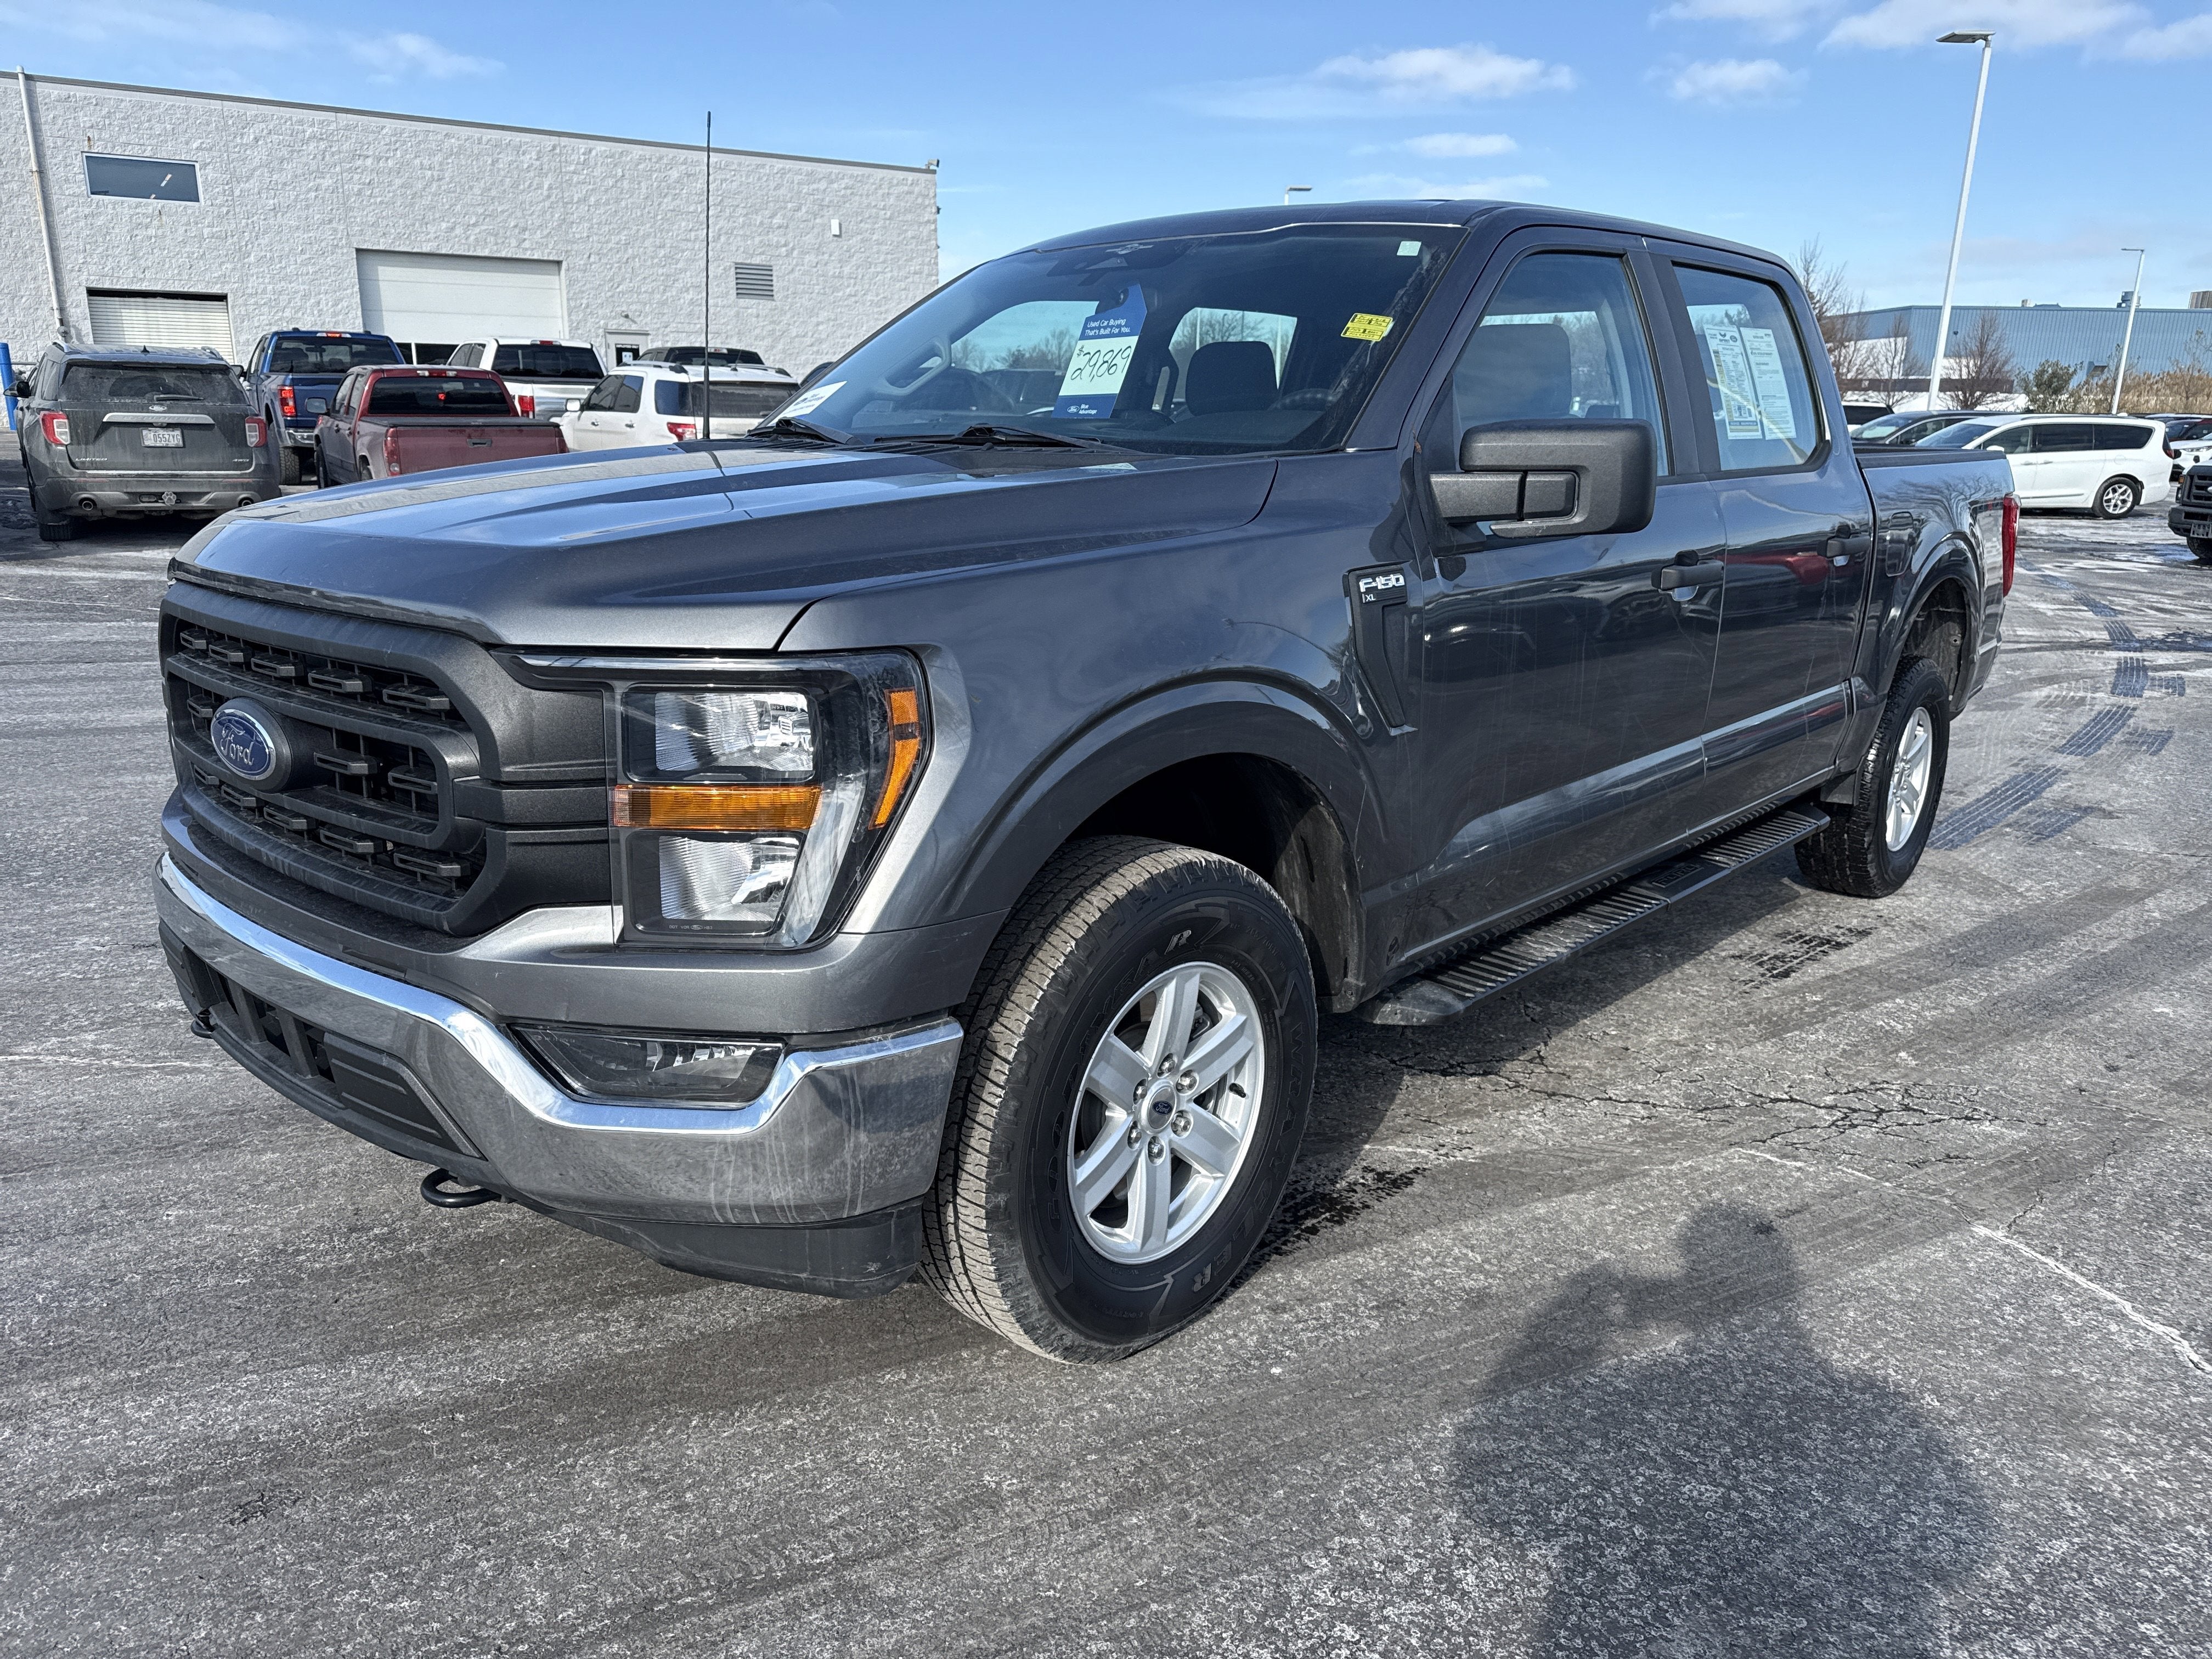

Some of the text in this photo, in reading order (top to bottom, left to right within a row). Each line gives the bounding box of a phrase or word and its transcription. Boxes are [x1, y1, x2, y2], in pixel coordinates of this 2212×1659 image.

[1109, 318, 1126, 326] Buying
[1359, 573, 1405, 592] F-150
[1365, 594, 1376, 602] XL
[221, 723, 254, 766] Ford
[1155, 1102, 1170, 1114] Ford
[1192, 1022, 1306, 1293] WRANGLER
